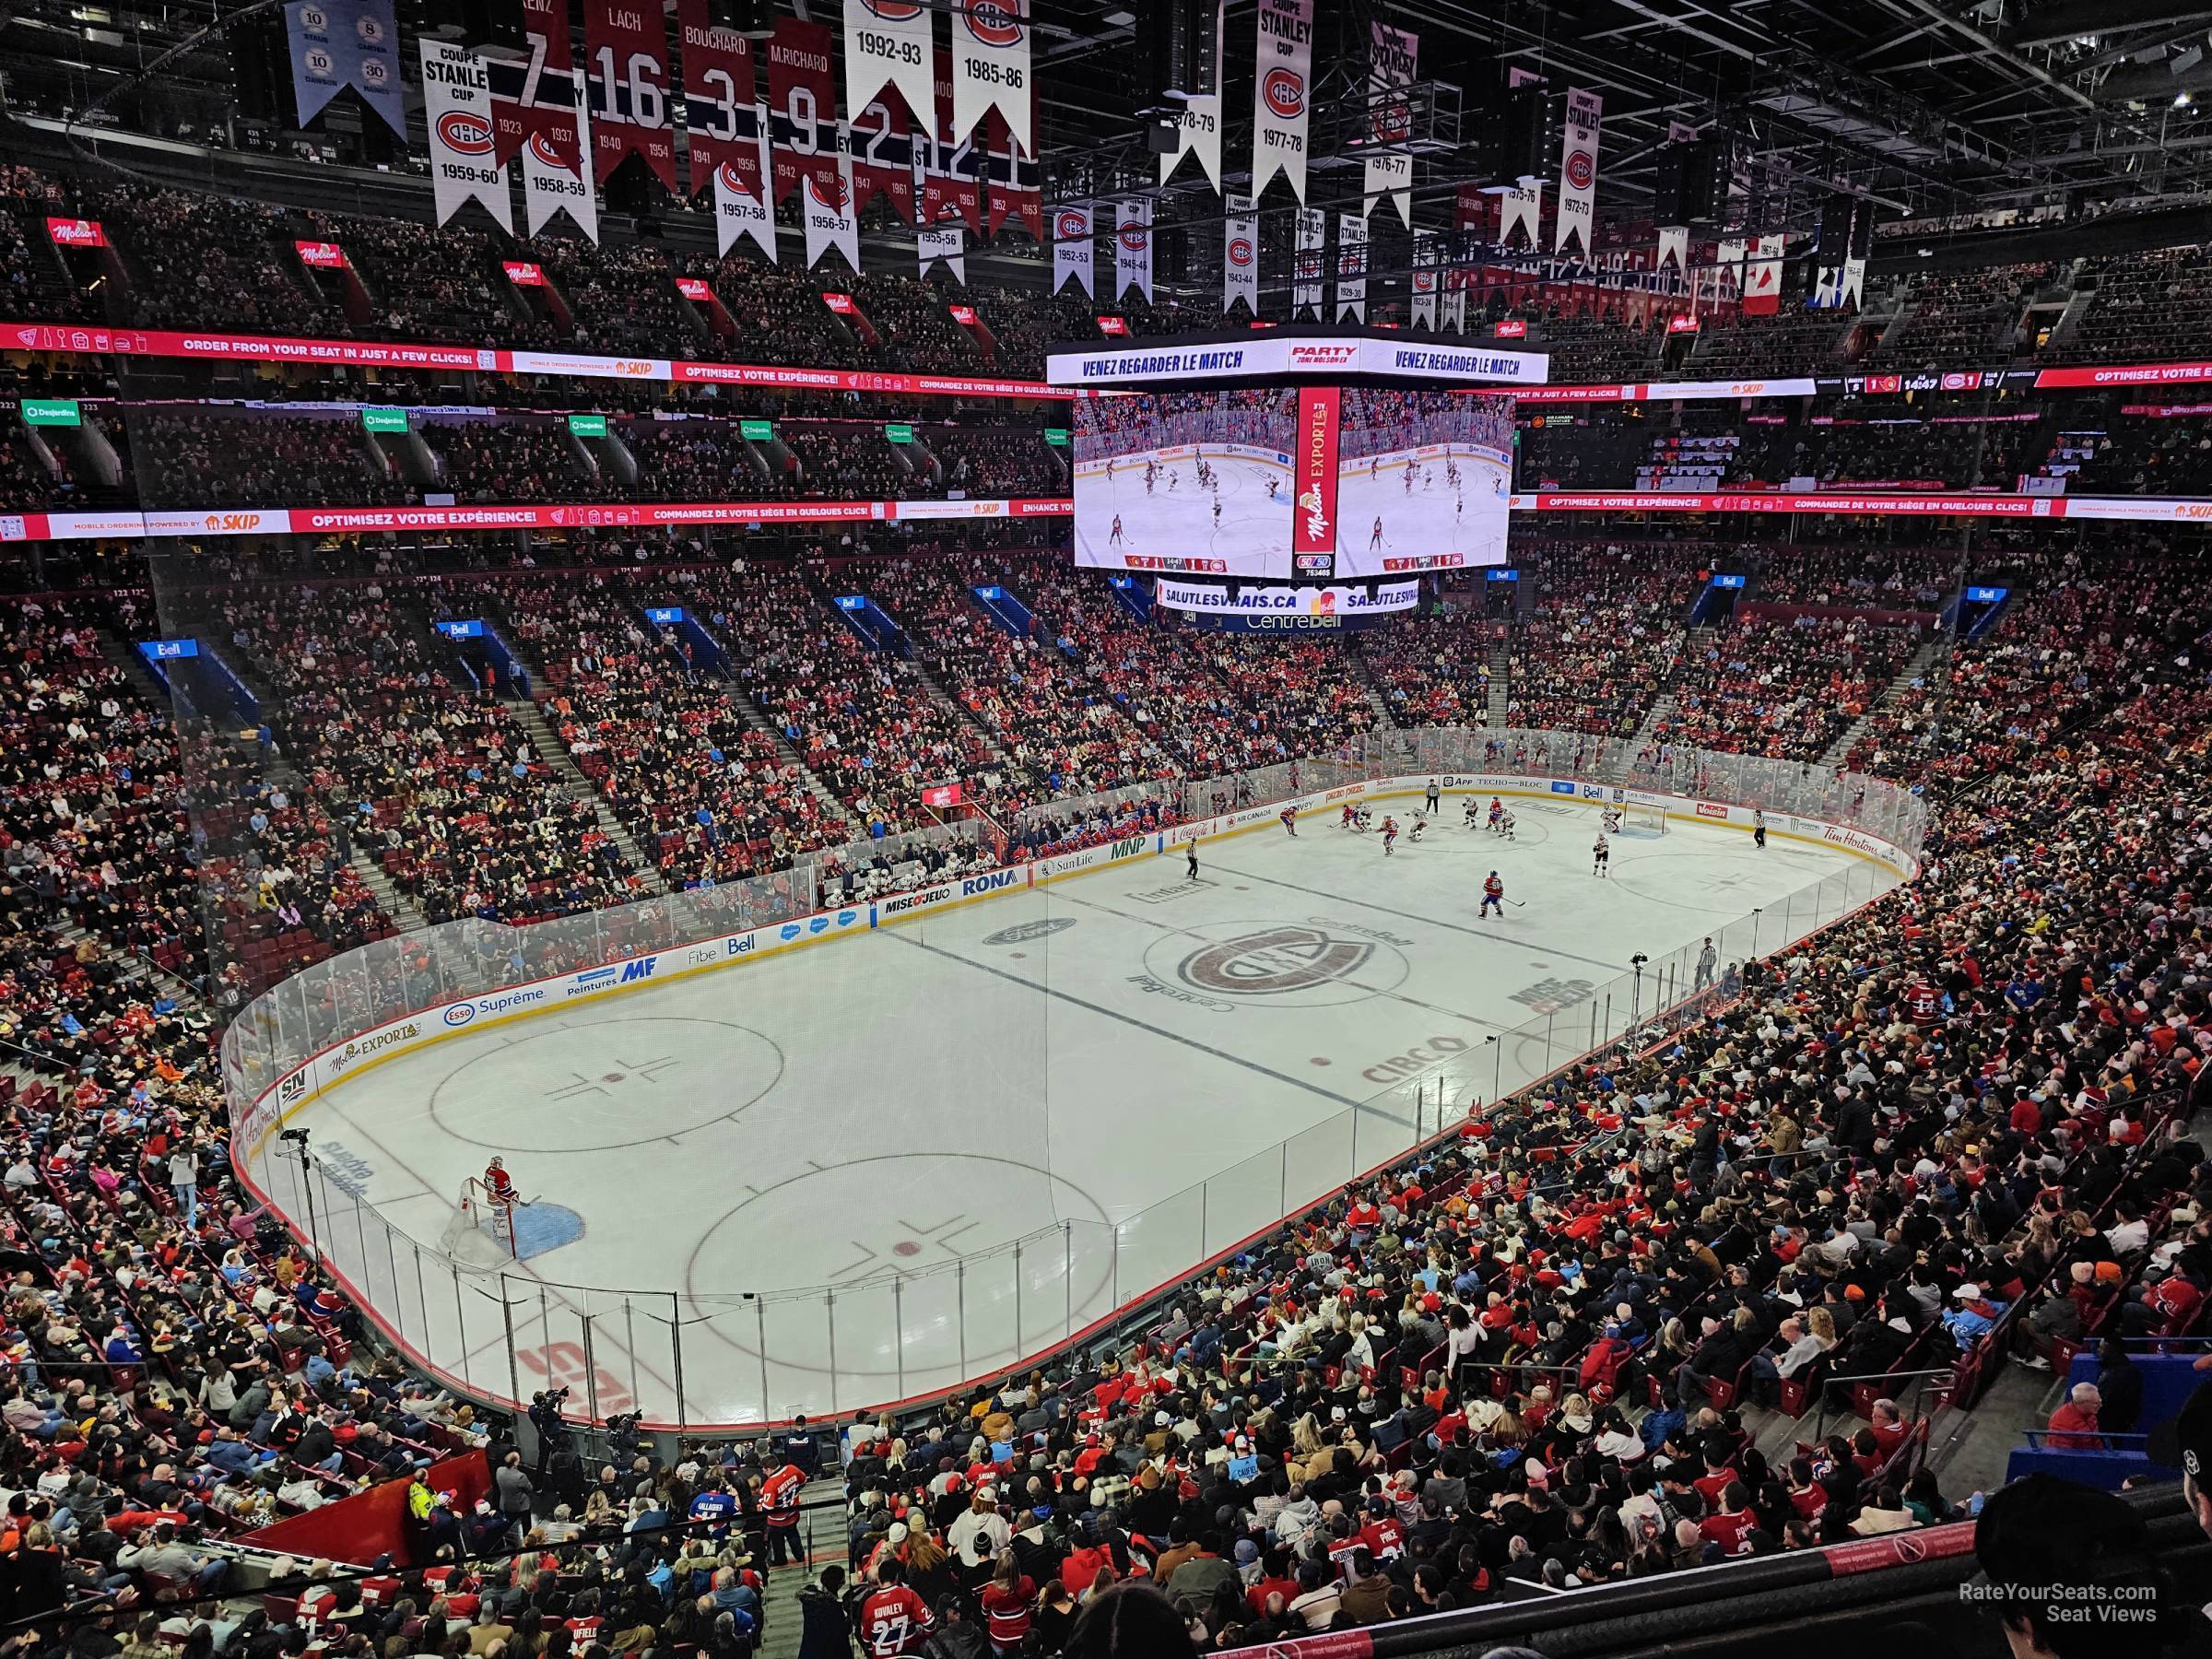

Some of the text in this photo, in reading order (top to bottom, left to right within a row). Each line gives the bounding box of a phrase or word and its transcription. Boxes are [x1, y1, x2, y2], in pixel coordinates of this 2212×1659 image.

[607, 7, 641, 31] LACH
[1261, 12, 1312, 46] STANLEY
[685, 25, 747, 56] BOUCHARD
[856, 30, 922, 65] 1992-93
[1277, 41, 1293, 57] CUP
[440, 48, 479, 66] COUPE
[525, 31, 547, 108] 7
[965, 57, 1023, 89] 1985-86
[451, 88, 475, 102] CUP
[595, 46, 665, 130] 16
[703, 68, 737, 143] 3
[1576, 94, 1595, 109] COUPE
[499, 118, 523, 135] 1923
[788, 86, 818, 156] 9
[1568, 106, 1600, 132] STANLEY
[599, 135, 621, 150] 1940
[1263, 128, 1302, 152] 1977-78
[1577, 129, 1588, 141] CUP
[649, 143, 669, 159] 1954
[693, 149, 711, 165] 1941
[737, 157, 756, 171] 1956
[777, 164, 796, 178] 1942
[441, 163, 499, 184] 1959-60
[817, 170, 834, 183] 1960
[533, 176, 586, 196] 1958-59
[854, 176, 870, 190] 1947
[892, 182, 907, 194] 1961
[926, 187, 941, 201] 1951
[959, 194, 975, 206] 1963
[722, 202, 766, 221] 1957-58
[992, 198, 1006, 211] 1952
[1565, 198, 1589, 216] 1972-73
[811, 214, 851, 231] 1956-57
[1347, 218, 1361, 229] COUPE
[53, 224, 97, 240] Molson
[1340, 227, 1367, 242] STANLEY
[300, 247, 336, 261] Molson
[1058, 249, 1088, 264] 1952-53
[507, 267, 538, 280] Molson
[1228, 272, 1253, 284] 1943-44
[183, 339, 473, 364] ORDER FROM YOUR SEAT IN JUST A FEW CLICKS!
[1291, 347, 1358, 356] PARTY
[626, 362, 653, 375] SKIP
[1083, 350, 1243, 377] VENEZ REGARDER LE MATCH
[1395, 350, 1520, 376] VENEZ REGARDER LE MATCH
[686, 367, 839, 384] OPTIMISEZ VOTRE EXPÉRIENCE!
[1967, 376, 1974, 386] 1
[2094, 369, 2159, 382] OPTIMISEZ
[2161, 368, 2201, 380] VOTRE
[920, 380, 962, 390] COMMANDEZ
[973, 383, 994, 392] VOTRE
[995, 383, 1013, 393] SIÈGE
[1024, 386, 1055, 395] QUELQUES
[1739, 383, 1764, 394] SKIP
[1870, 379, 1877, 390] 1
[1904, 379, 1937, 391] 14:47
[39, 407, 76, 418] Desjardins
[83, 403, 99, 411] 223
[375, 417, 405, 426] Desjardins
[580, 421, 604, 430] Desjardins
[1549, 497, 1701, 507] OPTIMISEZ VOTRE EXPÉRIENCE!
[1794, 500, 1851, 510] COMMANDEZ
[1852, 501, 1865, 510] DE
[1866, 501, 1897, 510] VOTRE
[1898, 500, 1924, 510] SIÈGE
[1943, 502, 1993, 512] QUELQUES
[1995, 502, 2027, 512] CLICS!
[312, 510, 537, 528] OPTIMISEZ VOTRE EXPÉRIENCE!
[653, 506, 868, 520] COMMANDEZ DE VOTRE SIÈGE EN QUELQUES CLICS!
[1306, 481, 1330, 542] Molson
[149, 521, 189, 529] POWERED
[222, 514, 261, 531] SKIP
[1979, 589, 1994, 600] Bell
[654, 609, 672, 622] Bell
[450, 622, 469, 636] Bell
[158, 642, 181, 657] Bell
[1325, 788, 1344, 805] pizza
[1346, 784, 1365, 799] pizza
[1583, 785, 1603, 799] Bell
[1236, 809, 1271, 823] AIR CANADA
[1700, 805, 1726, 818] Voisin
[1824, 826, 1842, 842] Tim
[1843, 831, 1878, 855] Hortons
[1111, 837, 1146, 860] MNP
[1057, 853, 1093, 871] Sun Life
[962, 870, 1016, 896] RONA
[728, 934, 755, 956] Bell
[688, 947, 717, 965] Fibe
[620, 957, 657, 983] MF
[568, 978, 618, 996] Peintures
[1124, 974, 1236, 1013] CentreBell
[479, 989, 546, 1014] Suprême
[448, 1008, 472, 1020] Esso
[330, 1045, 361, 1072] Molson
[1362, 1047, 1447, 1084] CIBC
[281, 1069, 306, 1100] SN
[1380, 1529, 1398, 1544] PRICE
[874, 1603, 903, 1618] KOVALEV
[874, 1615, 909, 1654] 27
[1309, 1632, 1356, 1644] Thank you for
